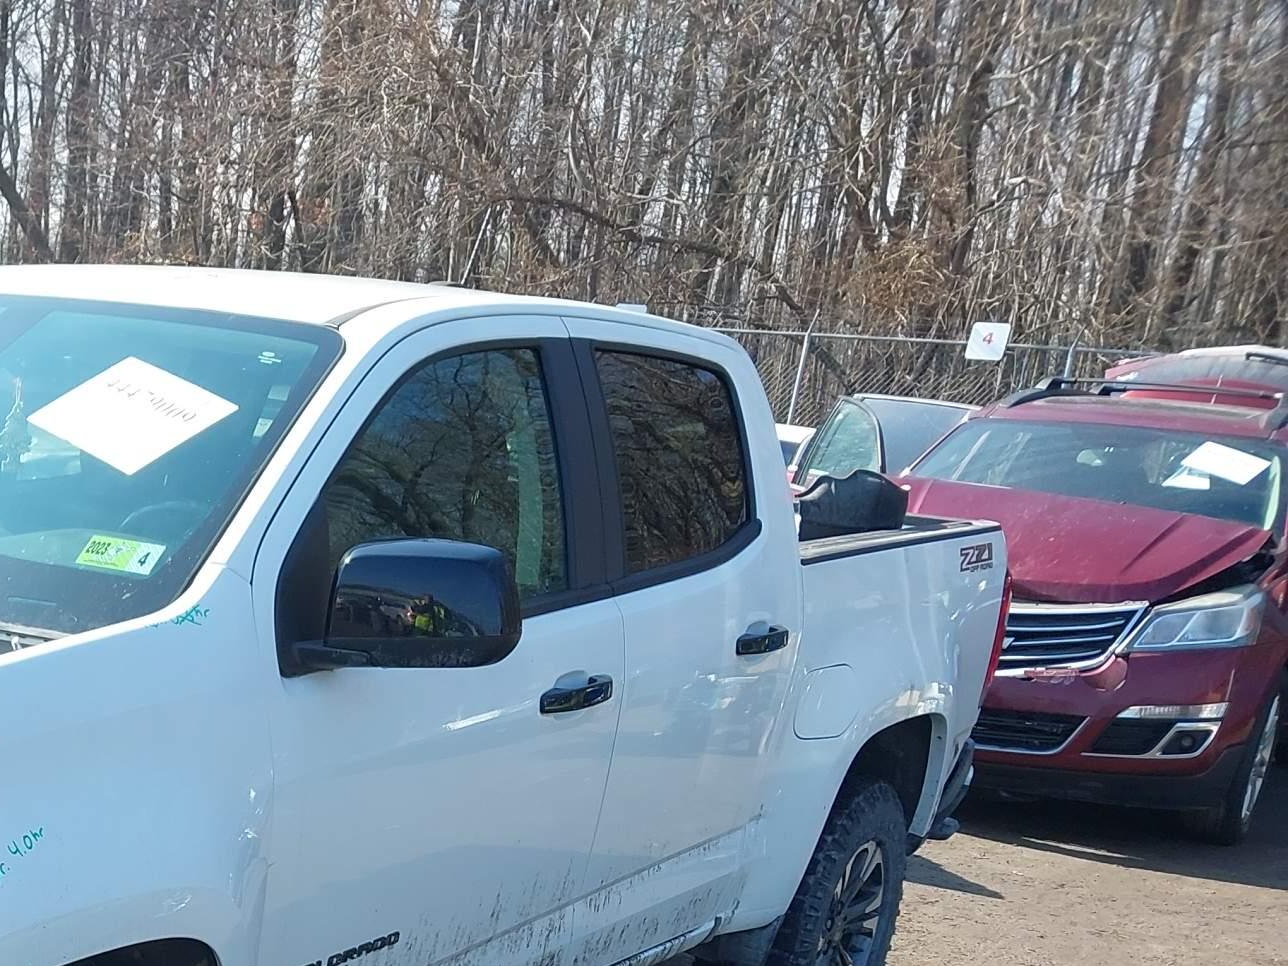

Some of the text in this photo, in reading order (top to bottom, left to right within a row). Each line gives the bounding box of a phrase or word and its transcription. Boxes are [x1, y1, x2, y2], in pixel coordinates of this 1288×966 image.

[982, 332, 994, 345] 4
[85, 539, 111, 555] 2023
[138, 551, 151, 567] 4
[959, 542, 993, 572] Z71
